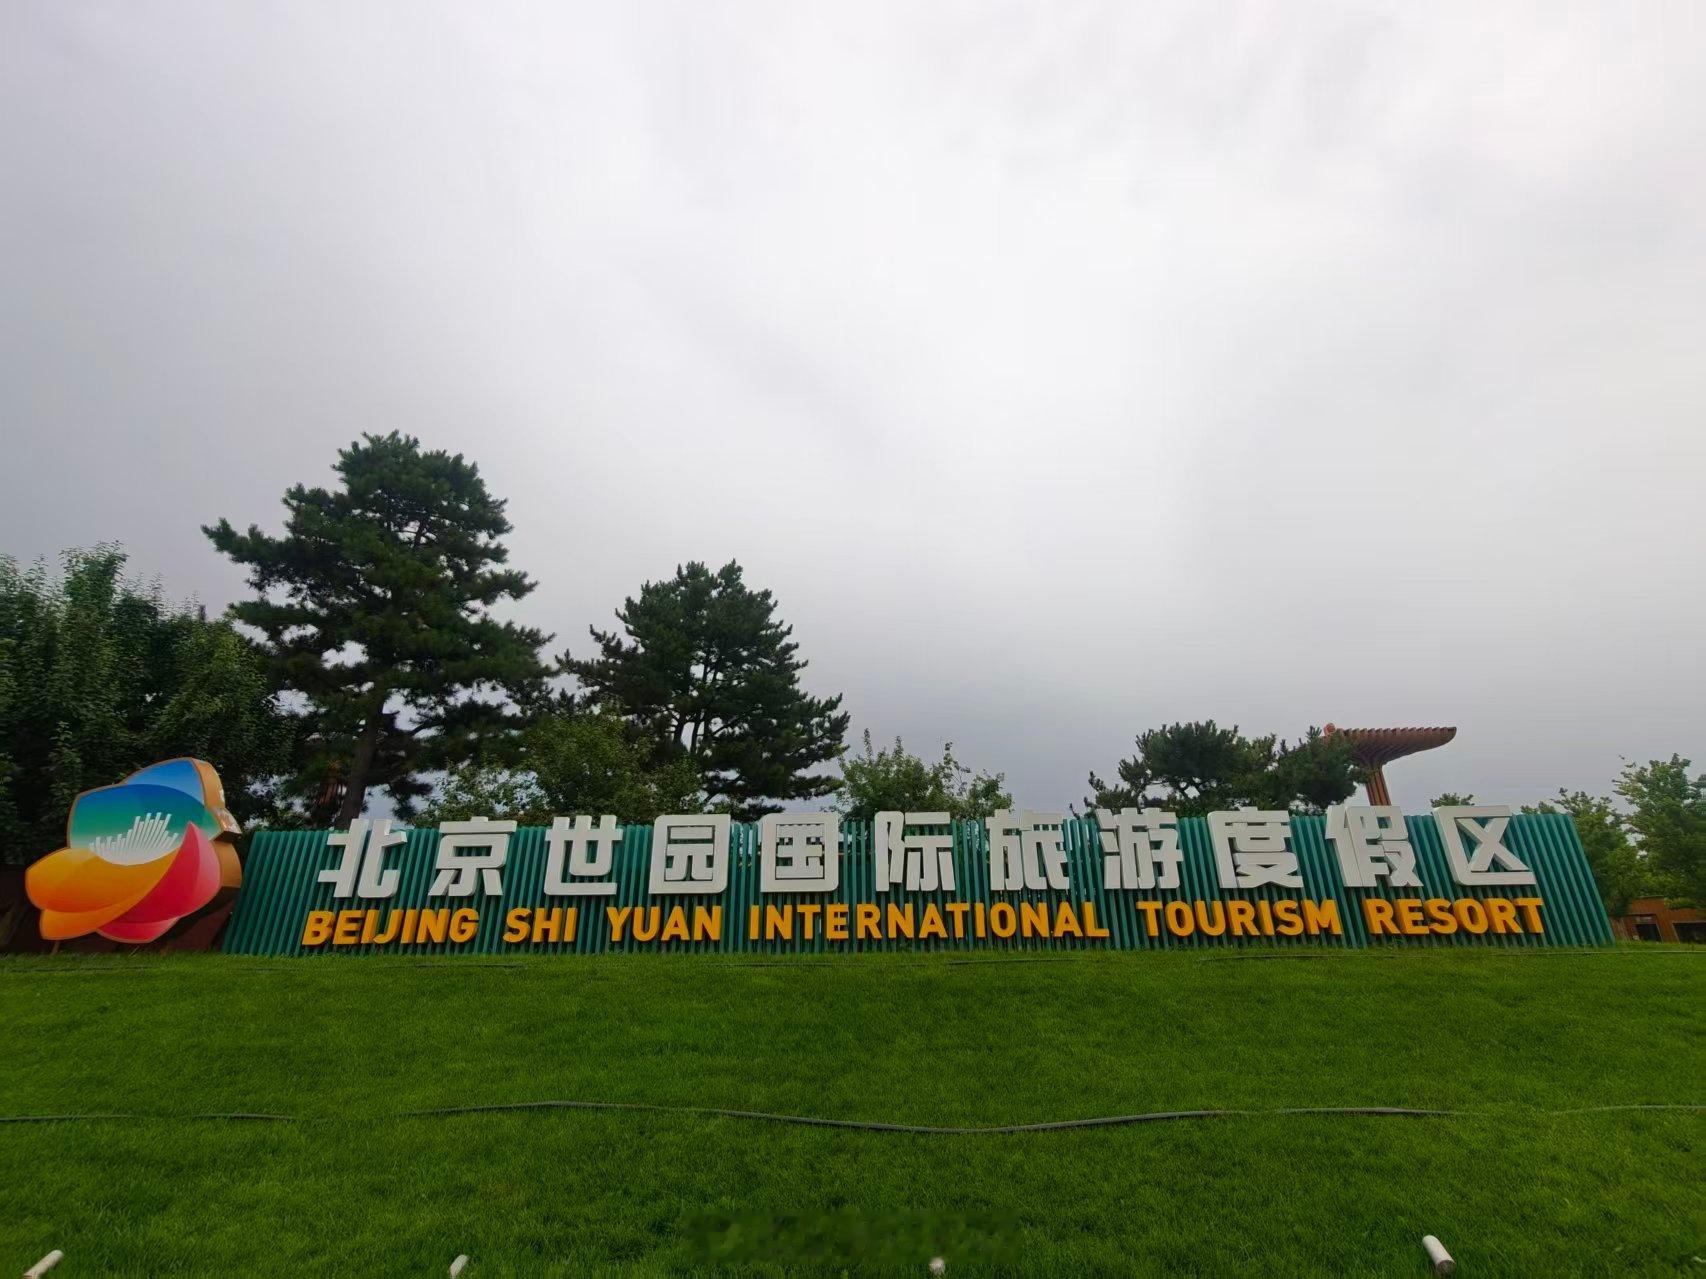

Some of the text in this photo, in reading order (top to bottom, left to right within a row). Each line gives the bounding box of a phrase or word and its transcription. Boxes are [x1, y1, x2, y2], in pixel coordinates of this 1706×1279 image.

[318, 804, 1537, 898] 北京世园国际旅游度假区
[302, 897, 1544, 946] BEIJING SHI YUAN INTERNATIONAL TOURISM RESORT
